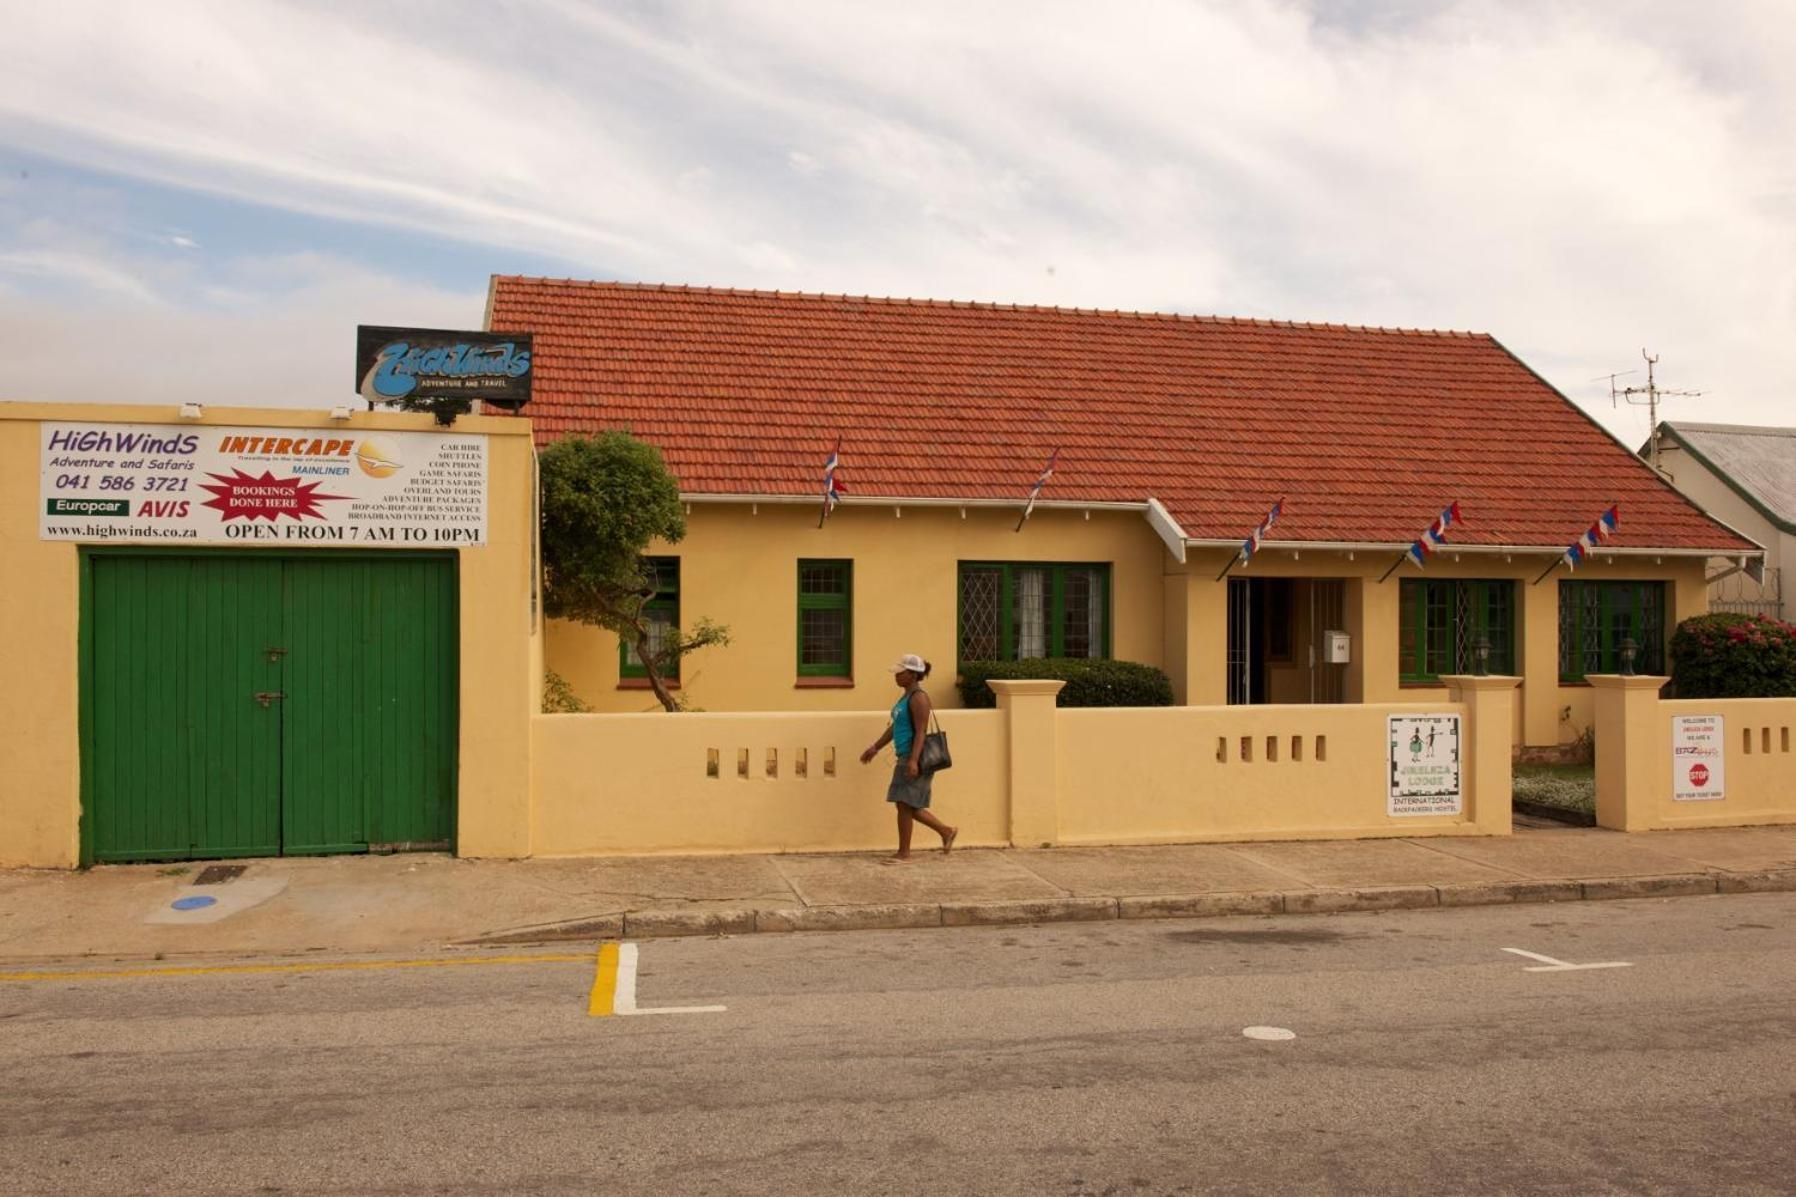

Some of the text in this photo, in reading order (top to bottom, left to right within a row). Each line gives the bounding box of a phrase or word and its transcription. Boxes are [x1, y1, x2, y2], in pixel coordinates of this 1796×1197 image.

[421, 379, 461, 387] ADVENTURE
[481, 379, 506, 387] TRAVEL
[219, 437, 354, 455] INTERCAPE
[49, 457, 195, 471] Adventure and Safaris
[292, 466, 350, 476] MAINLINER
[55, 474, 188, 491] 041 586 3721
[233, 486, 296, 497] BOOKINGS
[229, 498, 298, 508] DONE HERE
[436, 496, 481, 504] PACKAGES
[56, 499, 121, 514] Europcar
[137, 500, 191, 518] AVIS
[404, 513, 447, 521] INTERNET
[47, 524, 197, 539] www.highwinds.co.za
[225, 524, 480, 542] OPEN FROM 7 AM TO 10PM
[1689, 771, 1709, 780] STOP
[1393, 797, 1455, 805] INTERNATIONAL
